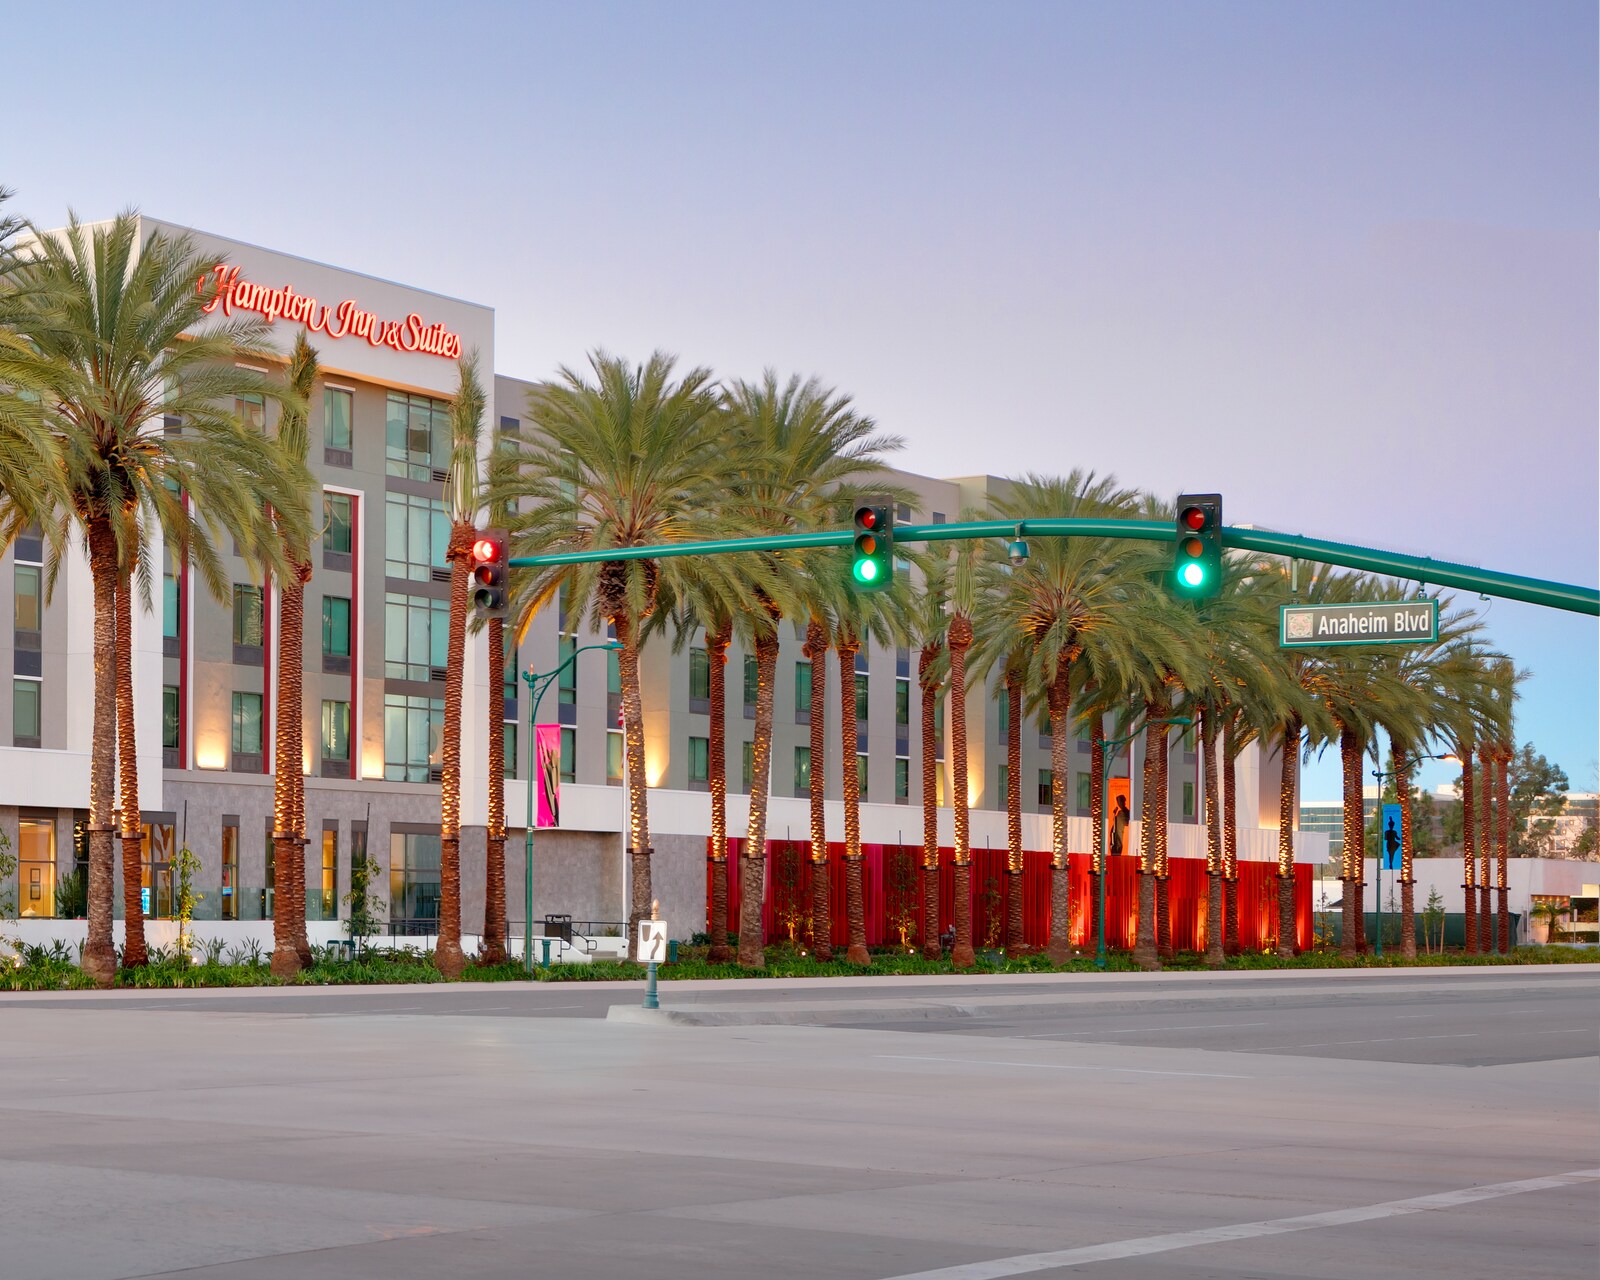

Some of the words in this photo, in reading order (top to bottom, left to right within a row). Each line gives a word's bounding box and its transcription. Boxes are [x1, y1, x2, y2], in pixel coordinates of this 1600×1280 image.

[197, 264, 328, 332] Hampton
[326, 299, 387, 347] Inn
[385, 320, 402, 351] &
[400, 312, 462, 359] Suites
[1318, 611, 1388, 635] Anaheim
[1394, 610, 1429, 633] Blvd
